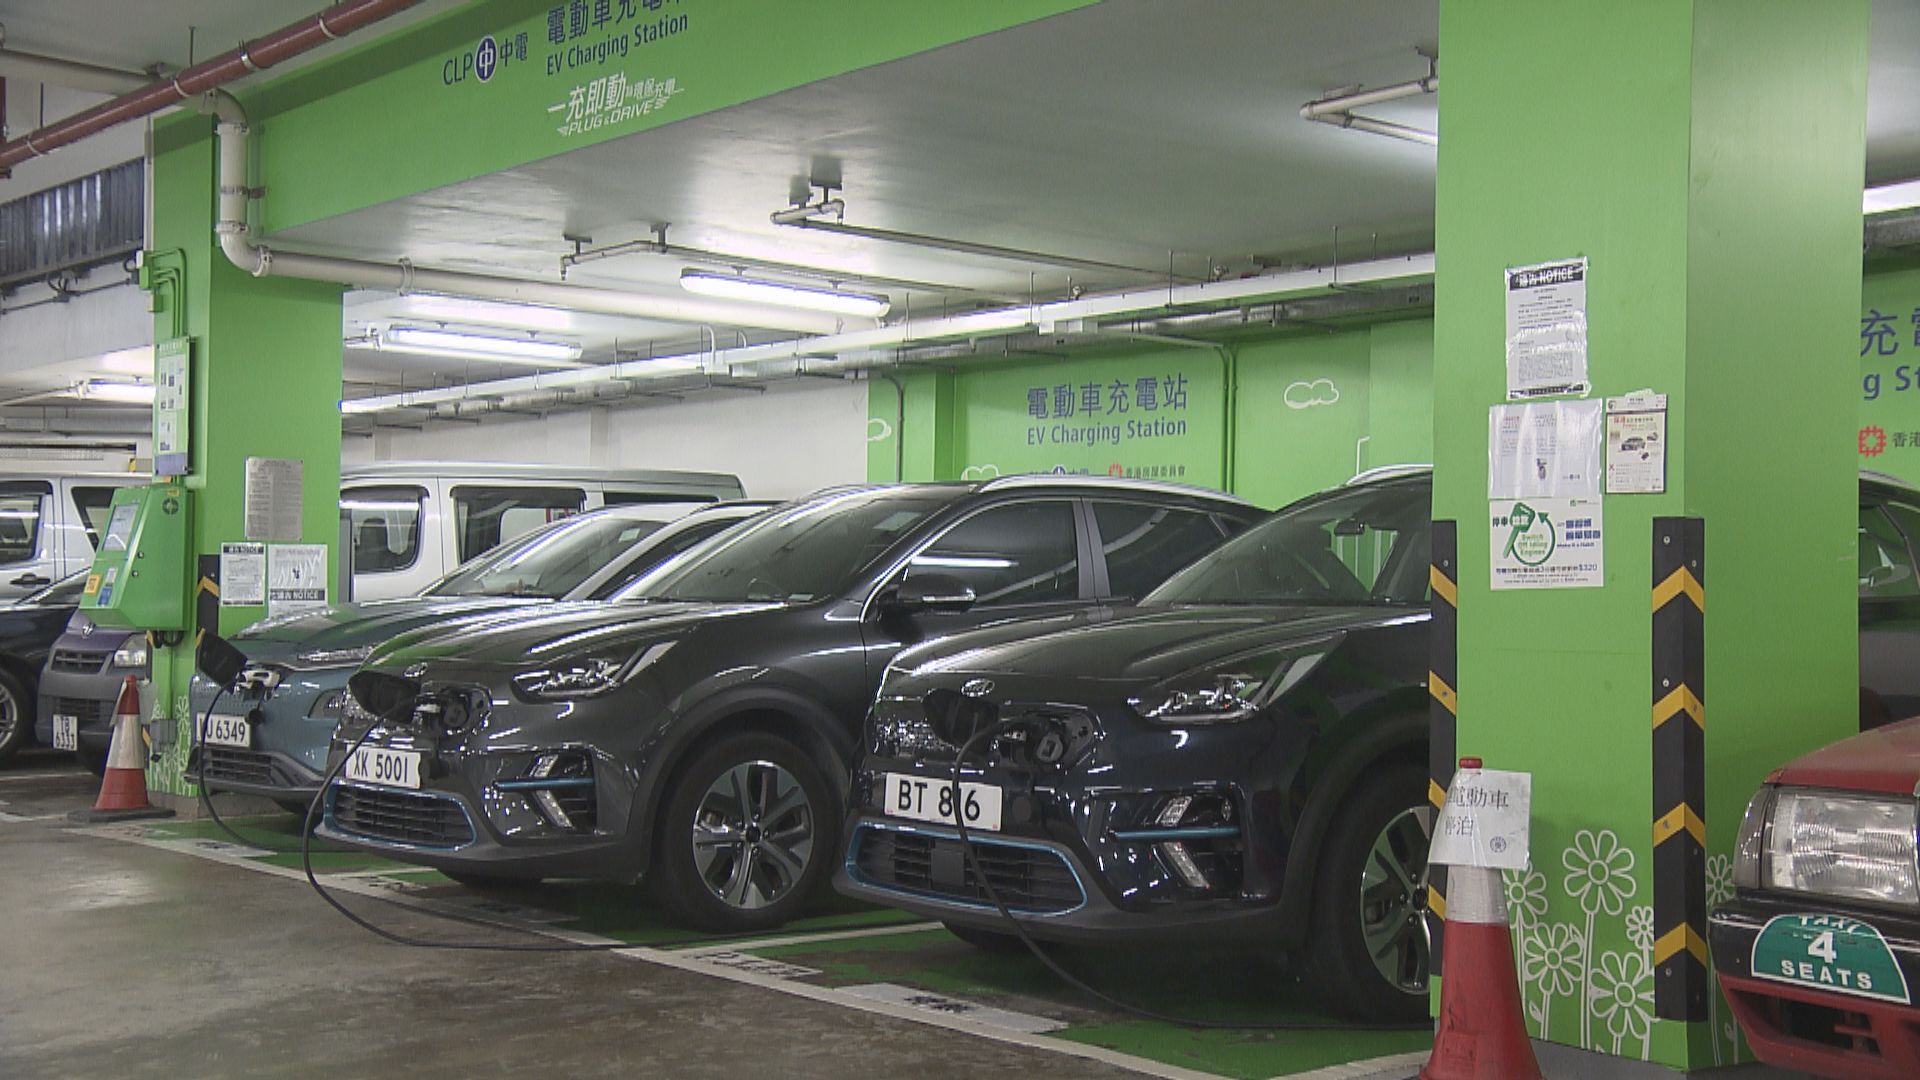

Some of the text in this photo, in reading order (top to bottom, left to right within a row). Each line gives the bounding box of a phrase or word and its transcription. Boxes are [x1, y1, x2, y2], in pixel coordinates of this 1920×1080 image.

[500, 31, 528, 68] 中電
[547, 13, 689, 76] EV Charging Station
[443, 54, 473, 86] CLP
[547, 71, 627, 124] 一充即動
[568, 112, 603, 137] PLUG
[610, 98, 655, 124] DRIVE
[1026, 372, 1189, 420] 電動車充電站
[1027, 417, 1187, 447] EV Charging Station
[292, 590, 319, 600] NOTICE
[215, 719, 246, 742] 6349
[353, 750, 408, 783] XK 5001
[898, 779, 928, 813] BT
[1807, 929, 1838, 965] 4
[1780, 958, 1873, 990] SEATS
